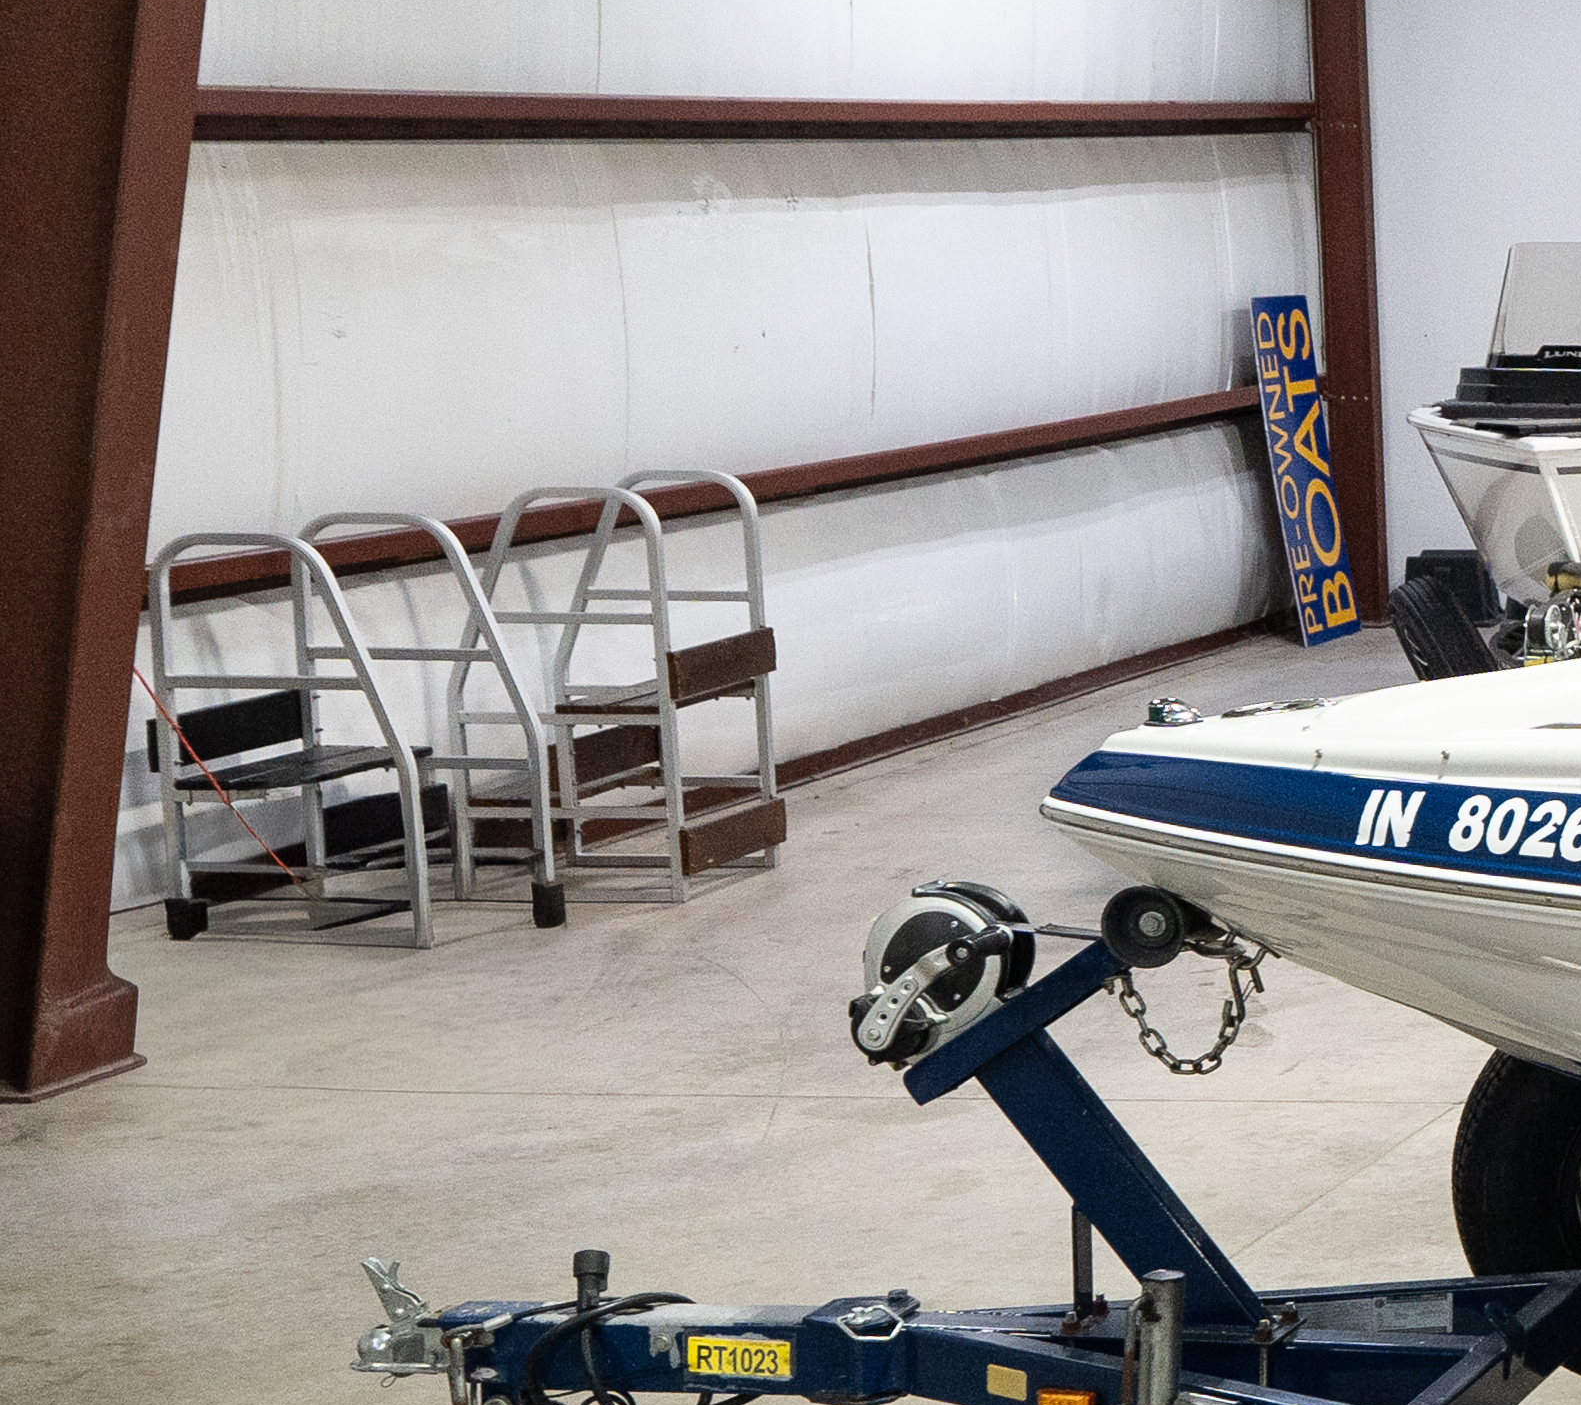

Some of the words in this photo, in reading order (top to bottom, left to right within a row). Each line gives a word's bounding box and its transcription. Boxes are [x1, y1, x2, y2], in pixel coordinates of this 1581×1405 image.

[1256, 311, 1323, 635] PRE-OWNED
[1277, 308, 1358, 630] BOATS
[1355, 789, 1426, 847] IN
[696, 1345, 779, 1374] RT1023
